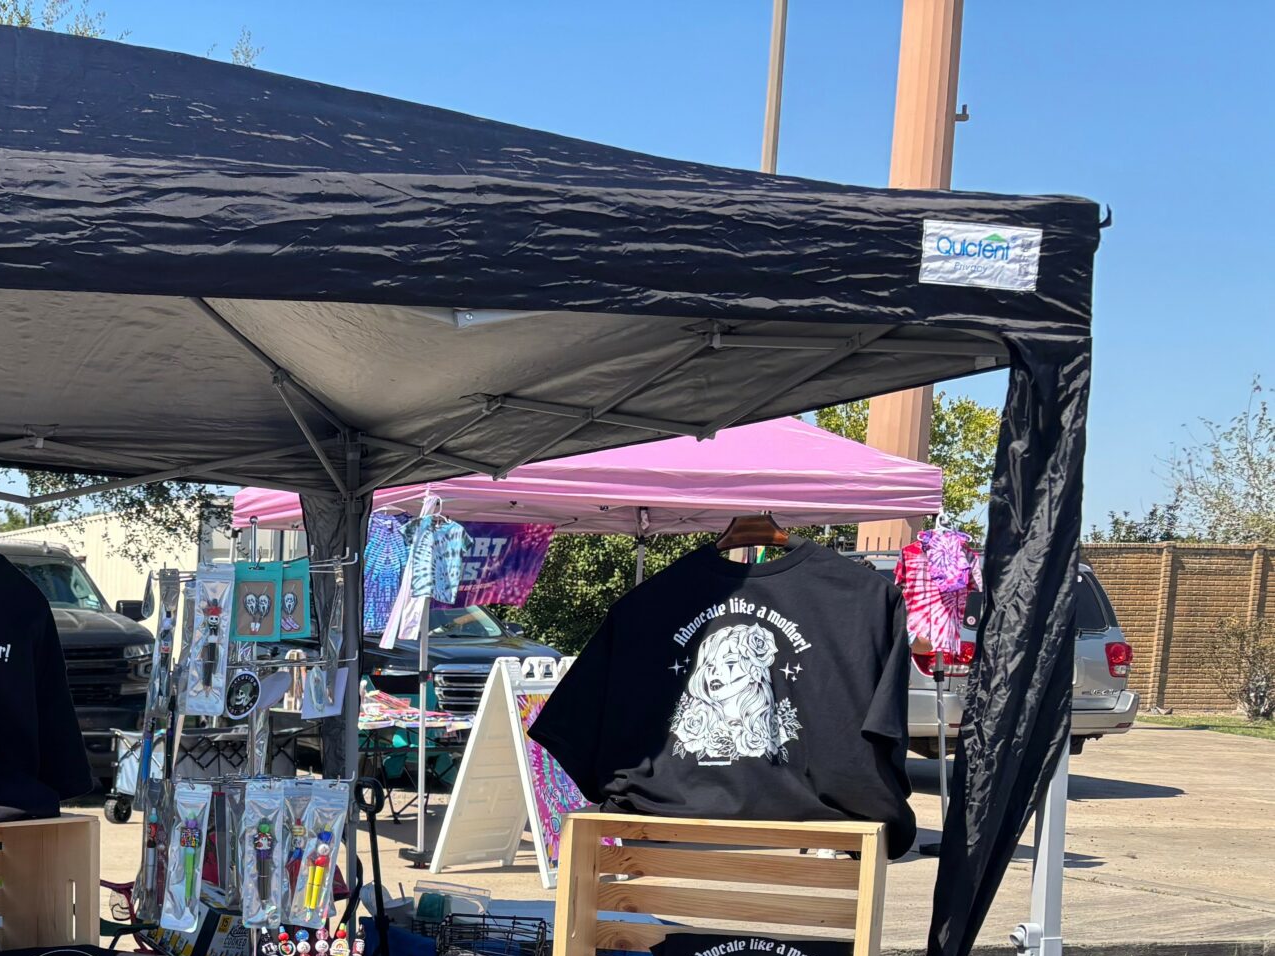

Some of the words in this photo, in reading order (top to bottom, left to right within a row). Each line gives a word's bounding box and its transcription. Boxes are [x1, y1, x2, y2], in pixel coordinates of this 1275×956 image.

[954, 262, 987, 273] Privacy
[673, 603, 726, 647] Advocate
[729, 598, 755, 614] like
[757, 606, 767, 618] a
[767, 609, 812, 653] mother!
[749, 938, 775, 951] like
[776, 943, 786, 956] a
